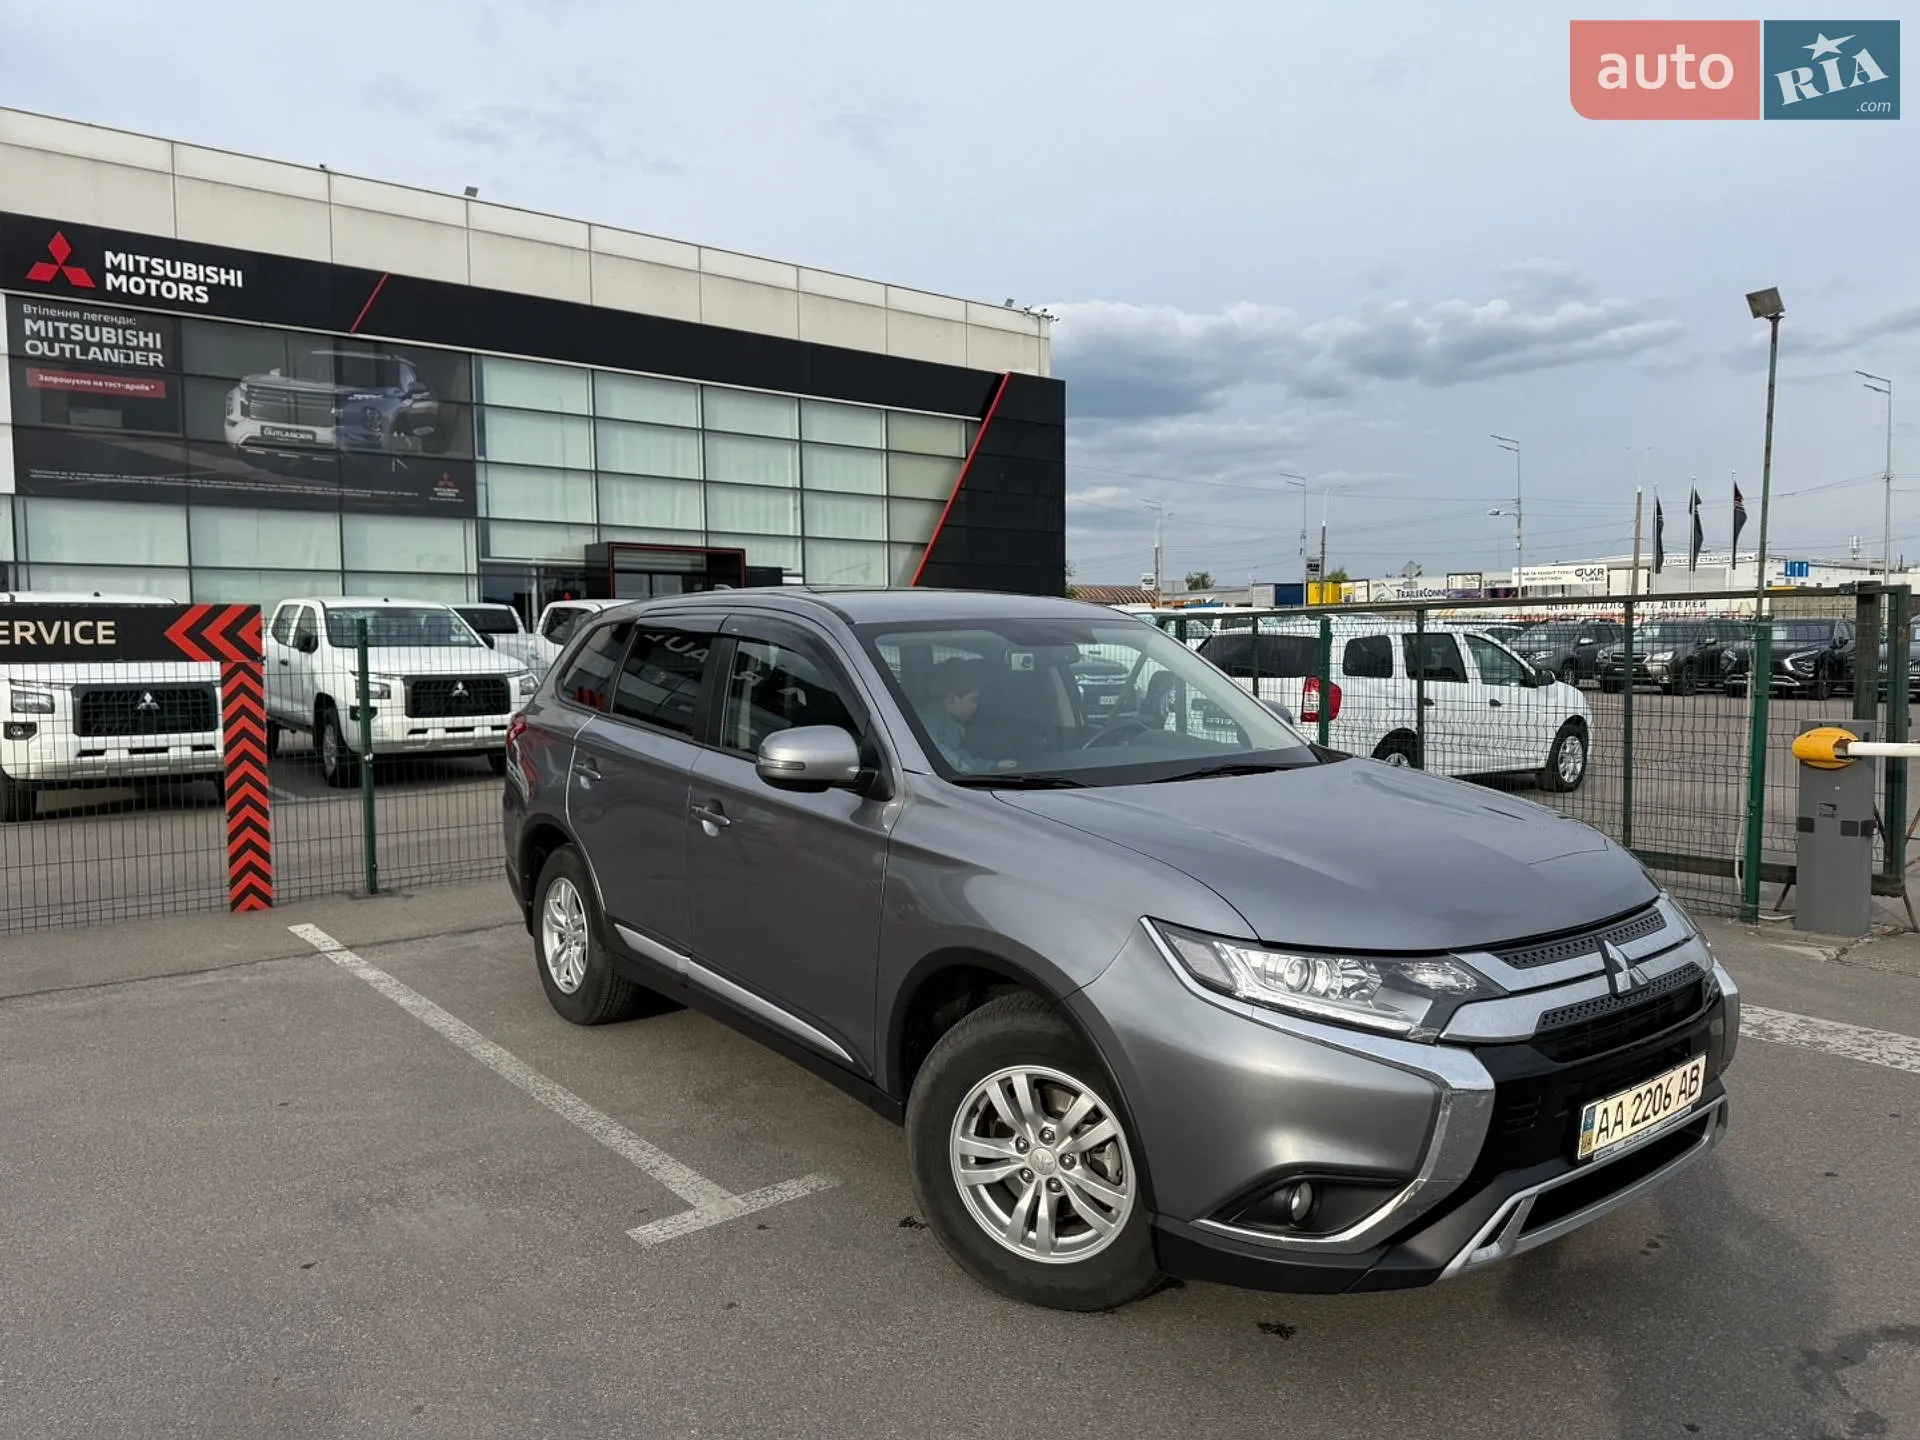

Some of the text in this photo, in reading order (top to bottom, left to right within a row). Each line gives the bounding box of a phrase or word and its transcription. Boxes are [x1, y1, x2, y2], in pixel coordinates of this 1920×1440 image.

[104, 250, 243, 288] MITSUBISHI
[105, 272, 209, 304] MOTORS
[22, 303, 136, 325] Втілення легенди:
[24, 318, 162, 349] MITSUBISHI
[24, 340, 165, 367] OUTLANDER
[1595, 1100, 1624, 1144] AA
[1631, 1077, 1673, 1128] 2206
[1677, 1065, 1700, 1105] AB
